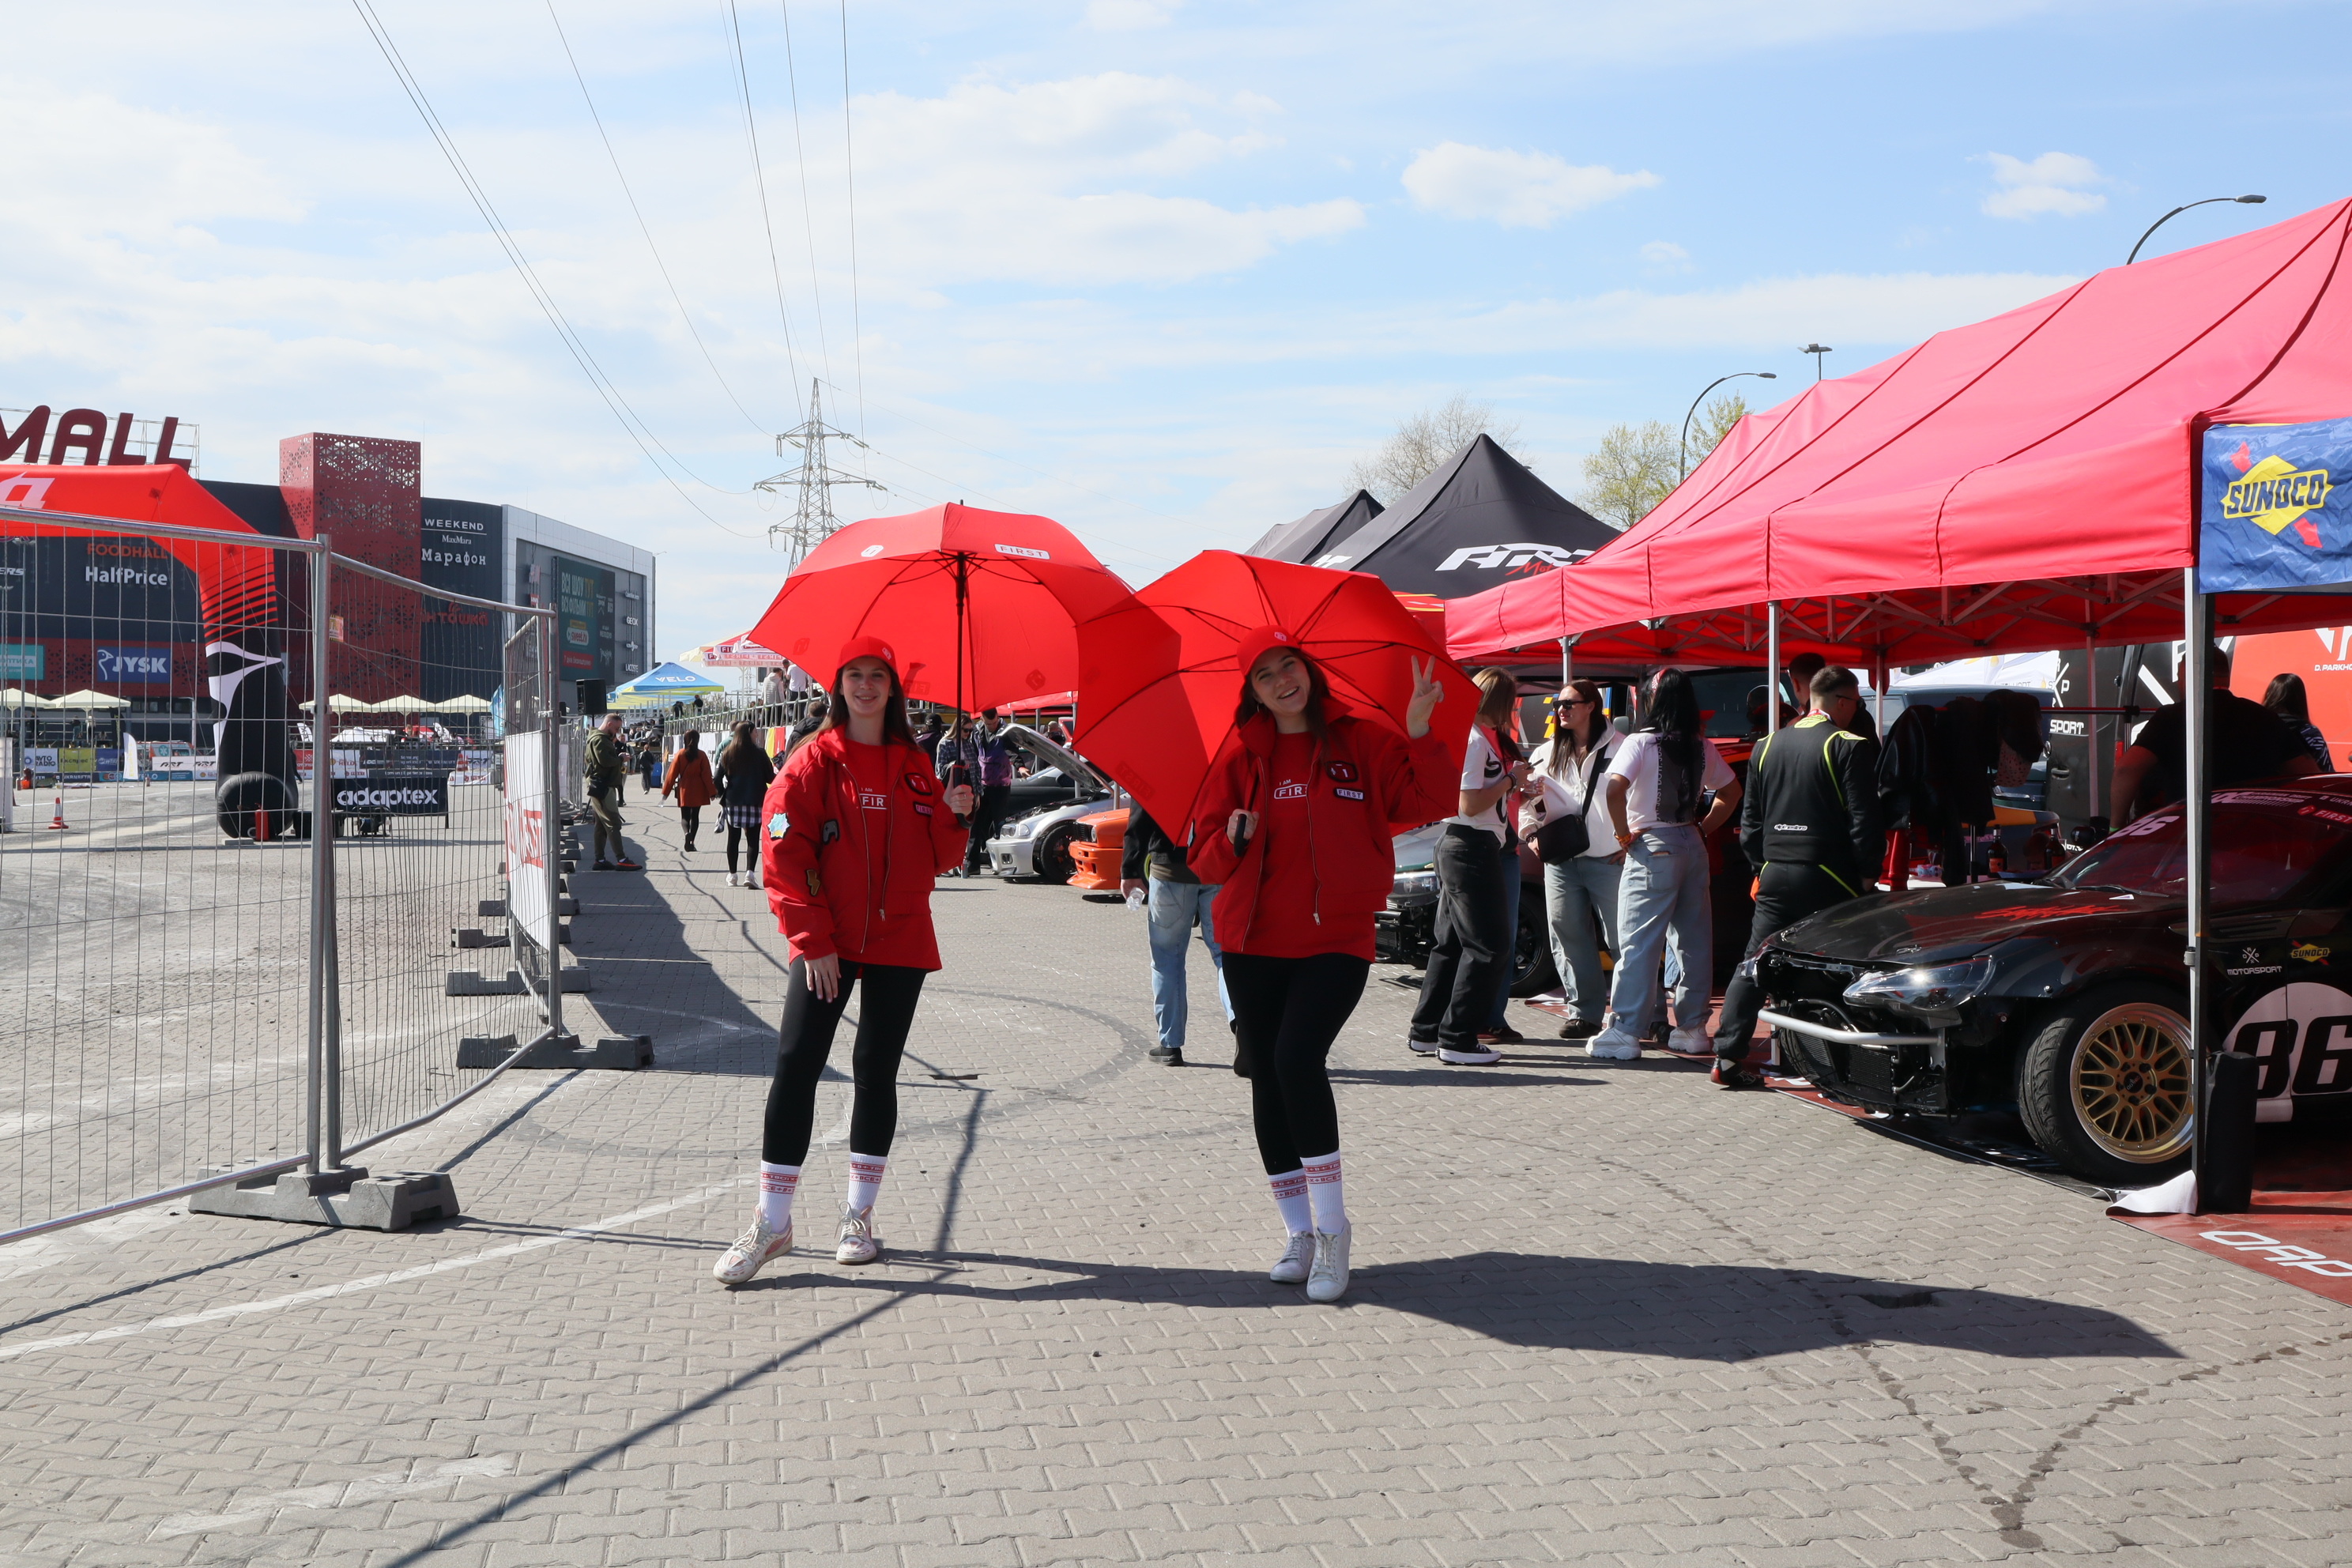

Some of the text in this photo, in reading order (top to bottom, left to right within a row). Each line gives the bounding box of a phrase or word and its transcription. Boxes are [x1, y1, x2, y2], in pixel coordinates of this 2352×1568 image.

[2228, 473, 2326, 515] SUNOCO
[424, 518, 484, 530] WEEKEND
[442, 534, 472, 545] MaxMara
[87, 543, 168, 559] FOODHALL
[421, 548, 486, 567] Марафон
[1000, 545, 1046, 558] FIRST
[85, 566, 168, 586] HalfPrice
[112, 657, 167, 673] JYSK
[337, 787, 439, 808] adaptex
[1338, 790, 1361, 799] FIRST
[2315, 810, 2352, 823] FIRST
[2293, 948, 2329, 957] SUNOCO
[2227, 966, 2282, 975] MOTORSPORT
